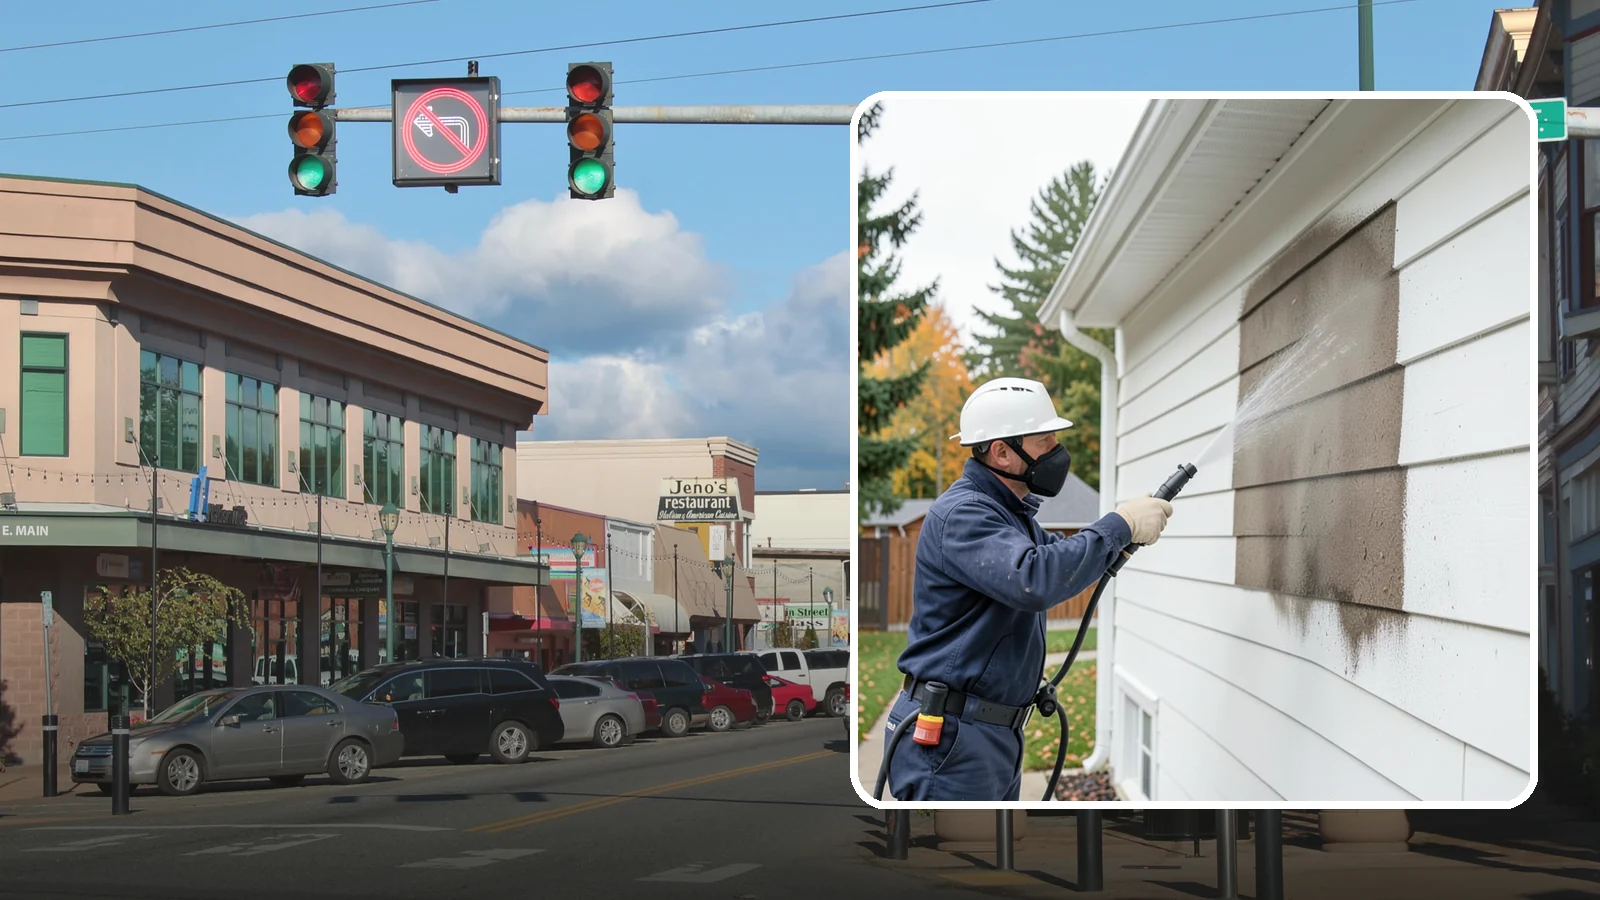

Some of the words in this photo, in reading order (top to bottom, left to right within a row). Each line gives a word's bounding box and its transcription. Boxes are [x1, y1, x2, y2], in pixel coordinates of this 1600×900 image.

[670, 480, 727, 494] Jeno's
[665, 496, 731, 509] restaurant
[659, 510, 681, 519] Italian
[686, 509, 715, 519] American
[715, 509, 738, 519] Cuisine
[2, 525, 13, 536] E.
[15, 525, 49, 536] MAIN
[797, 607, 828, 617] Street
